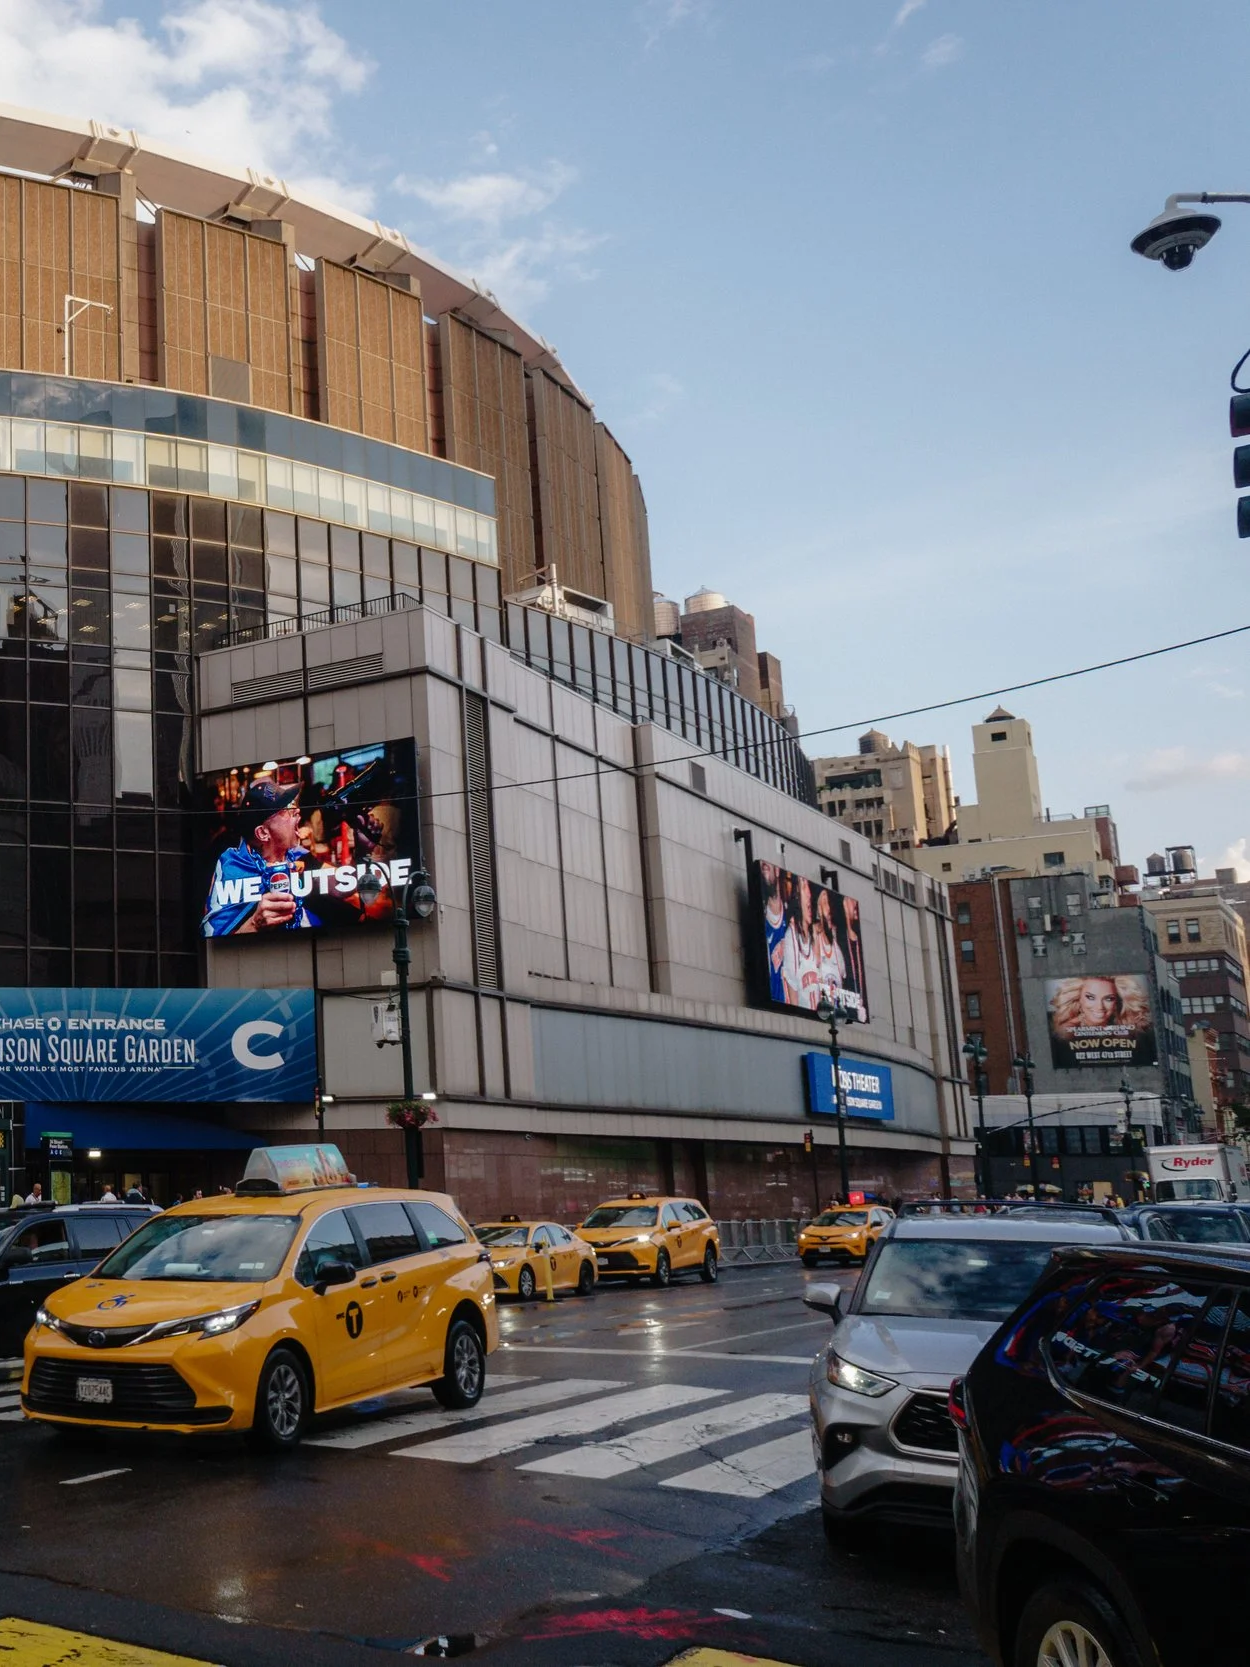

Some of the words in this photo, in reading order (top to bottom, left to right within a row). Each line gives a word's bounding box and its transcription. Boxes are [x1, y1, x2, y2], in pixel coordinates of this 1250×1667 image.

[215, 875, 263, 905] WE
[67, 1018, 166, 1031] ENTRANCE
[47, 1034, 118, 1063] SQUARE
[231, 1020, 285, 1070] C
[1069, 1039, 1100, 1050] NOW
[1102, 1038, 1137, 1048] OPEN
[14, 1065, 56, 1073] WORLD'S
[59, 1065, 85, 1073] MOST
[852, 1072, 880, 1093] THEATER
[1173, 1156, 1215, 1169] Ryder
